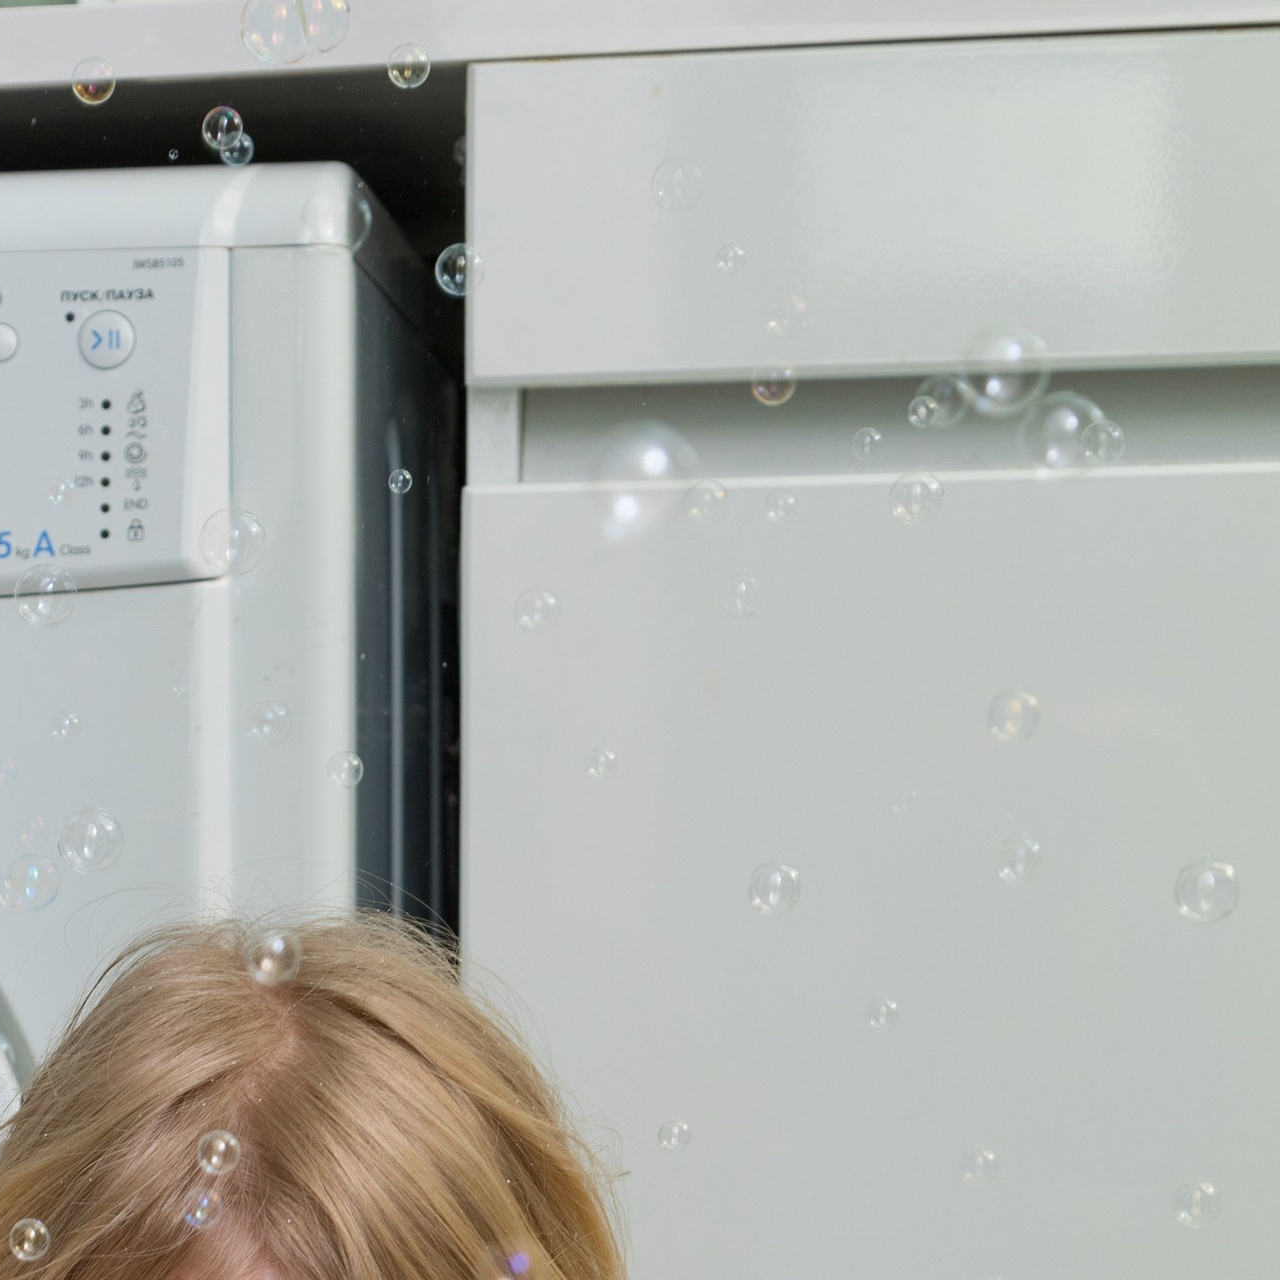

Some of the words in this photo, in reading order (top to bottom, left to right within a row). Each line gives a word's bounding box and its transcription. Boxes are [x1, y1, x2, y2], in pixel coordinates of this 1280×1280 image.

[60, 287, 154, 303] ПУСК/ПАУЗА
[123, 497, 149, 511] END
[32, 529, 56, 558] A
